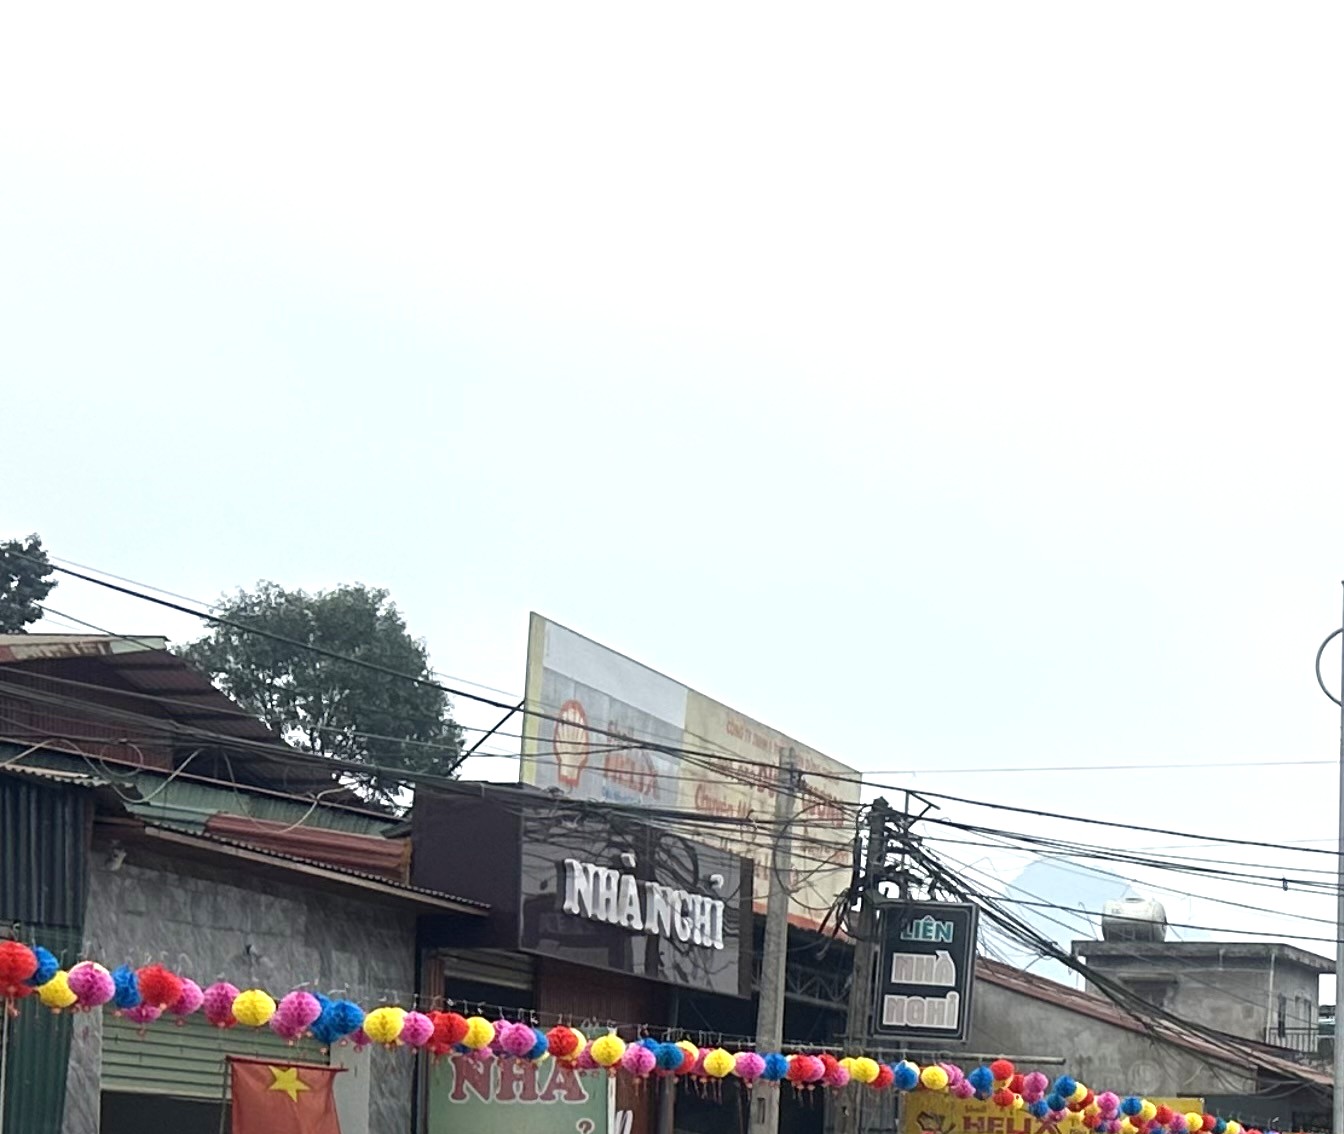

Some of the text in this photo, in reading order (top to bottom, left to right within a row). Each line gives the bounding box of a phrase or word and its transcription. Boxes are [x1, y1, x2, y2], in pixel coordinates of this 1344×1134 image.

[563, 852, 724, 949] NHÀ NGHỈ
[899, 914, 955, 944] LIÊN
[890, 949, 957, 987] NHÀ
[882, 990, 960, 1030] NGHỈ
